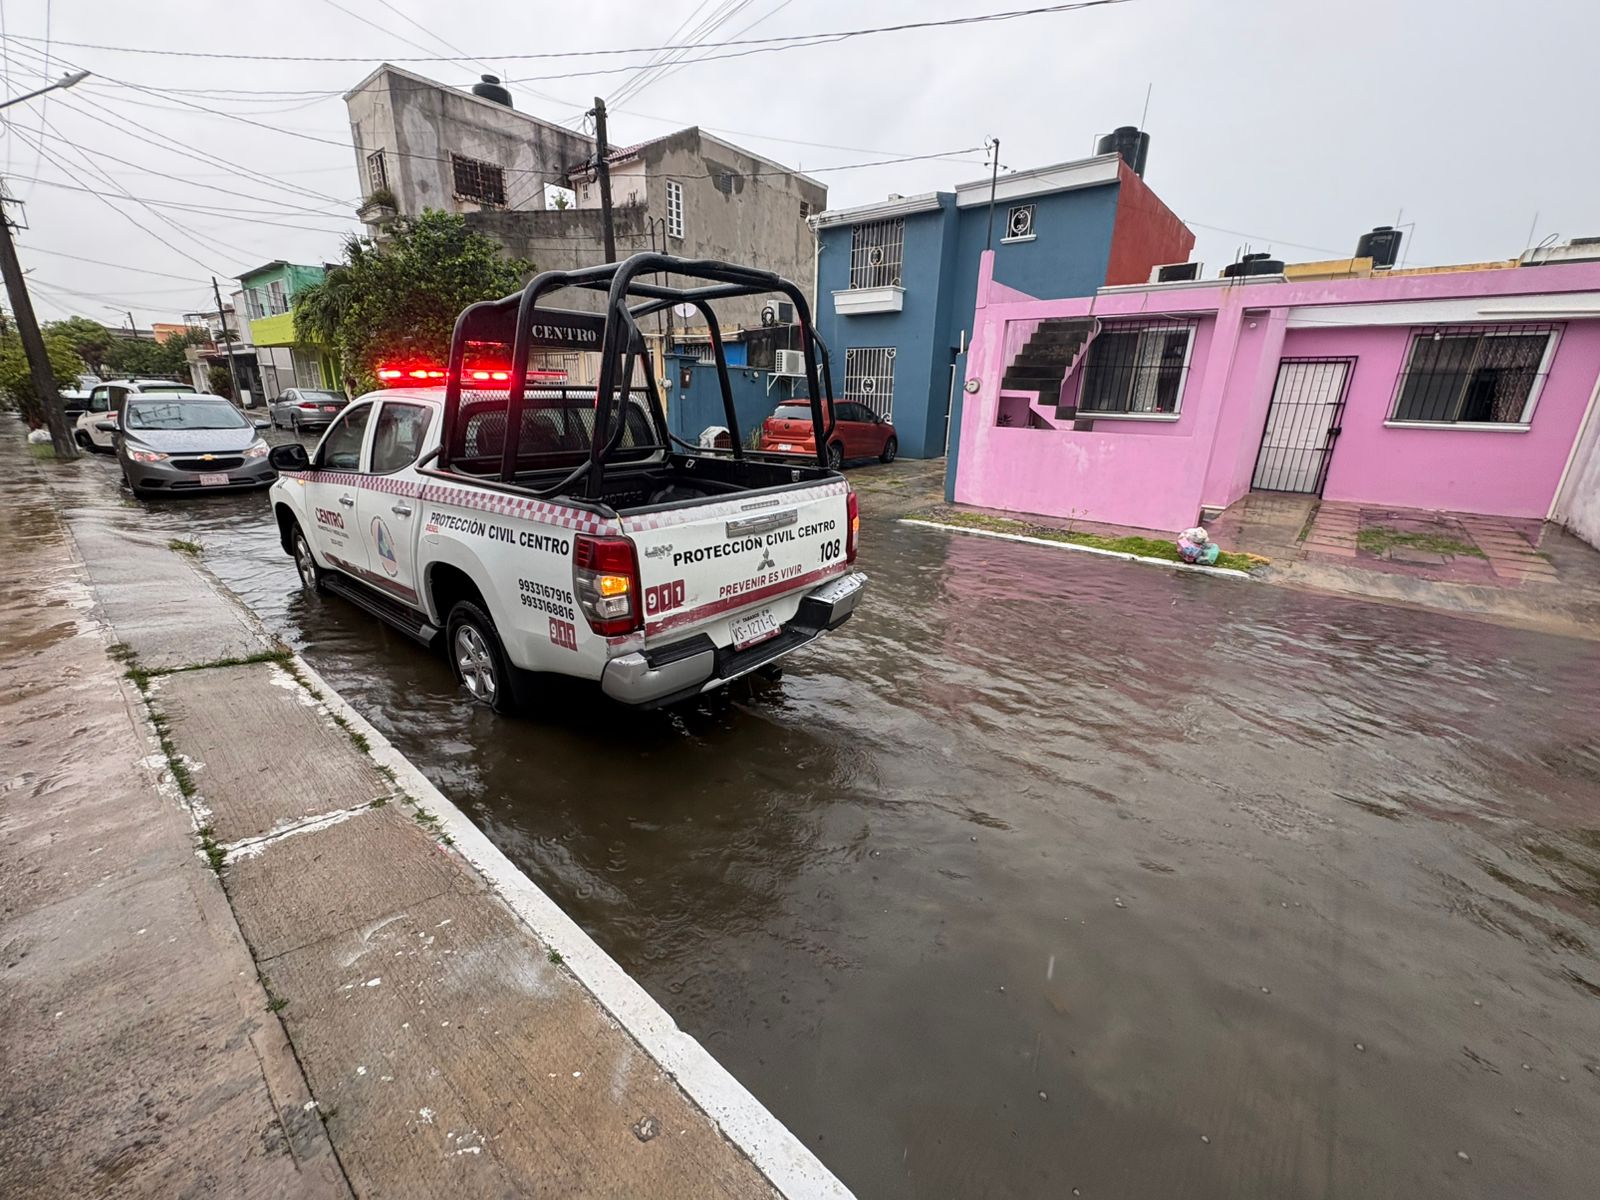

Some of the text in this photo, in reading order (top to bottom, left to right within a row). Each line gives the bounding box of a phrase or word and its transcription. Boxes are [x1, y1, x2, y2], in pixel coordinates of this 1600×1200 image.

[532, 325, 597, 342] CENTRO
[315, 507, 345, 530] CENTRO
[430, 511, 570, 556] PROTECCIÓN CIVIL CENTRO
[673, 519, 836, 567] PROTECCIÓN CIVIL CENTRO
[820, 538, 840, 562] 108
[518, 578, 573, 605] 9933167916
[719, 564, 802, 597] PREVENIR ES VIVIR
[520, 593, 575, 621] 9933168816
[648, 585, 682, 609] 911
[550, 622, 575, 645] 911
